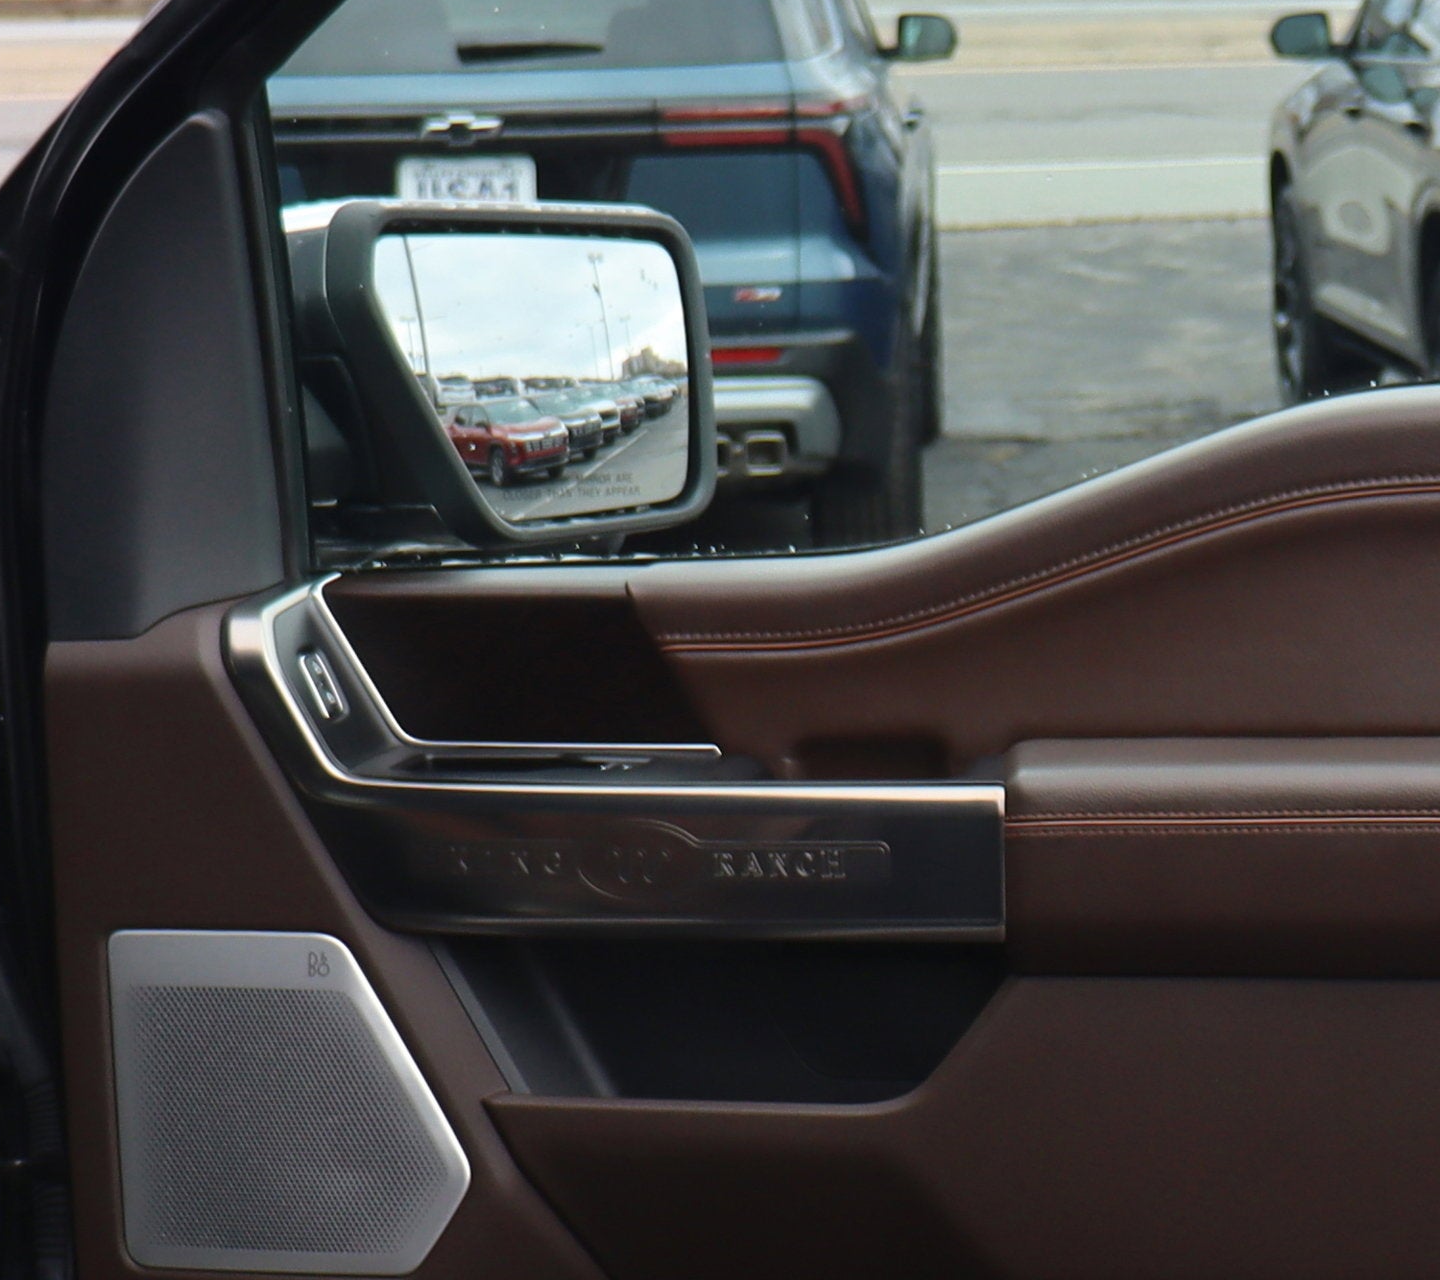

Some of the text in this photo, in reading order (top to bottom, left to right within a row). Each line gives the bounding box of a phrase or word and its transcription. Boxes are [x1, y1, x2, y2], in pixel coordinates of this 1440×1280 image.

[578, 487, 601, 497] THEY
[605, 485, 641, 496] APPEAR
[713, 849, 847, 879] RANCH
